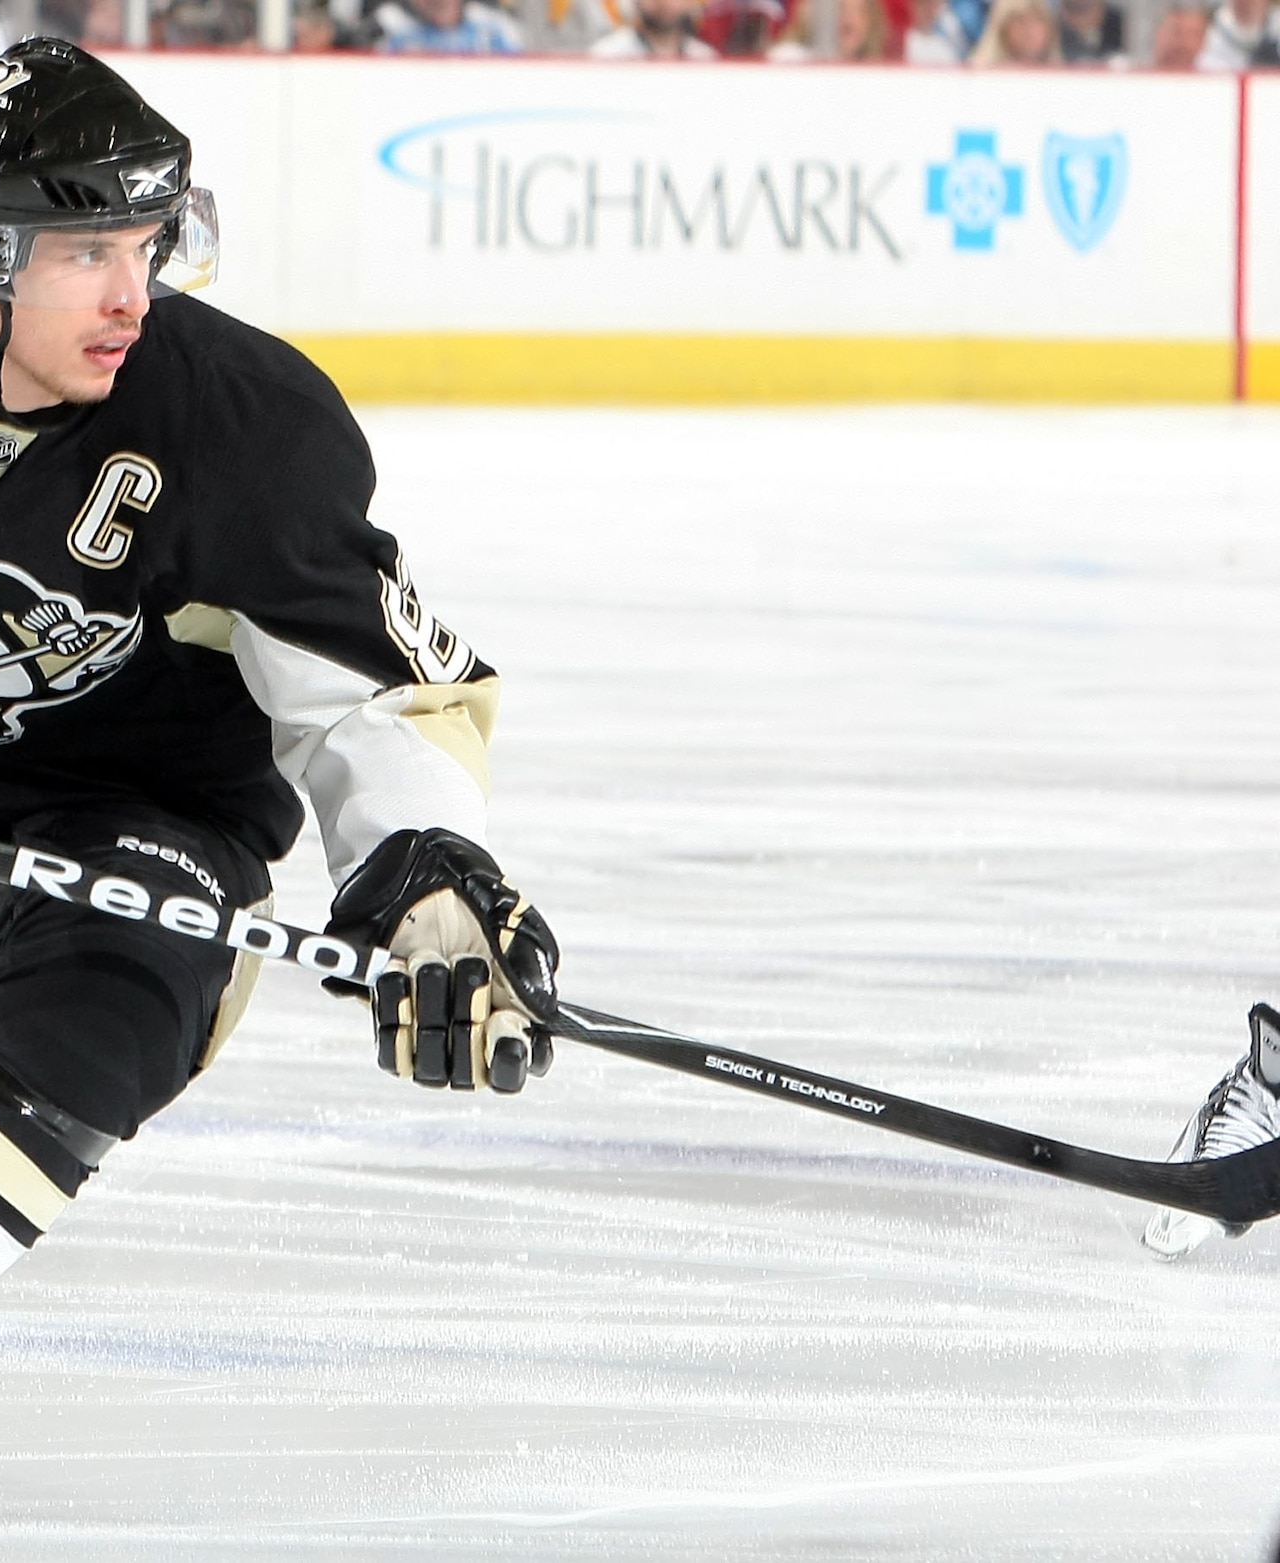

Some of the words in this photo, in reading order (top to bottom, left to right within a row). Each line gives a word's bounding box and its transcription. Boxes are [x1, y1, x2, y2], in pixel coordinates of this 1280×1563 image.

[426, 138, 903, 262] HIGHMARK
[66, 451, 163, 570] C
[116, 834, 226, 906] Reebok
[705, 1055, 764, 1082] SICKICK
[779, 1075, 886, 1115] TECHNOLOGY
